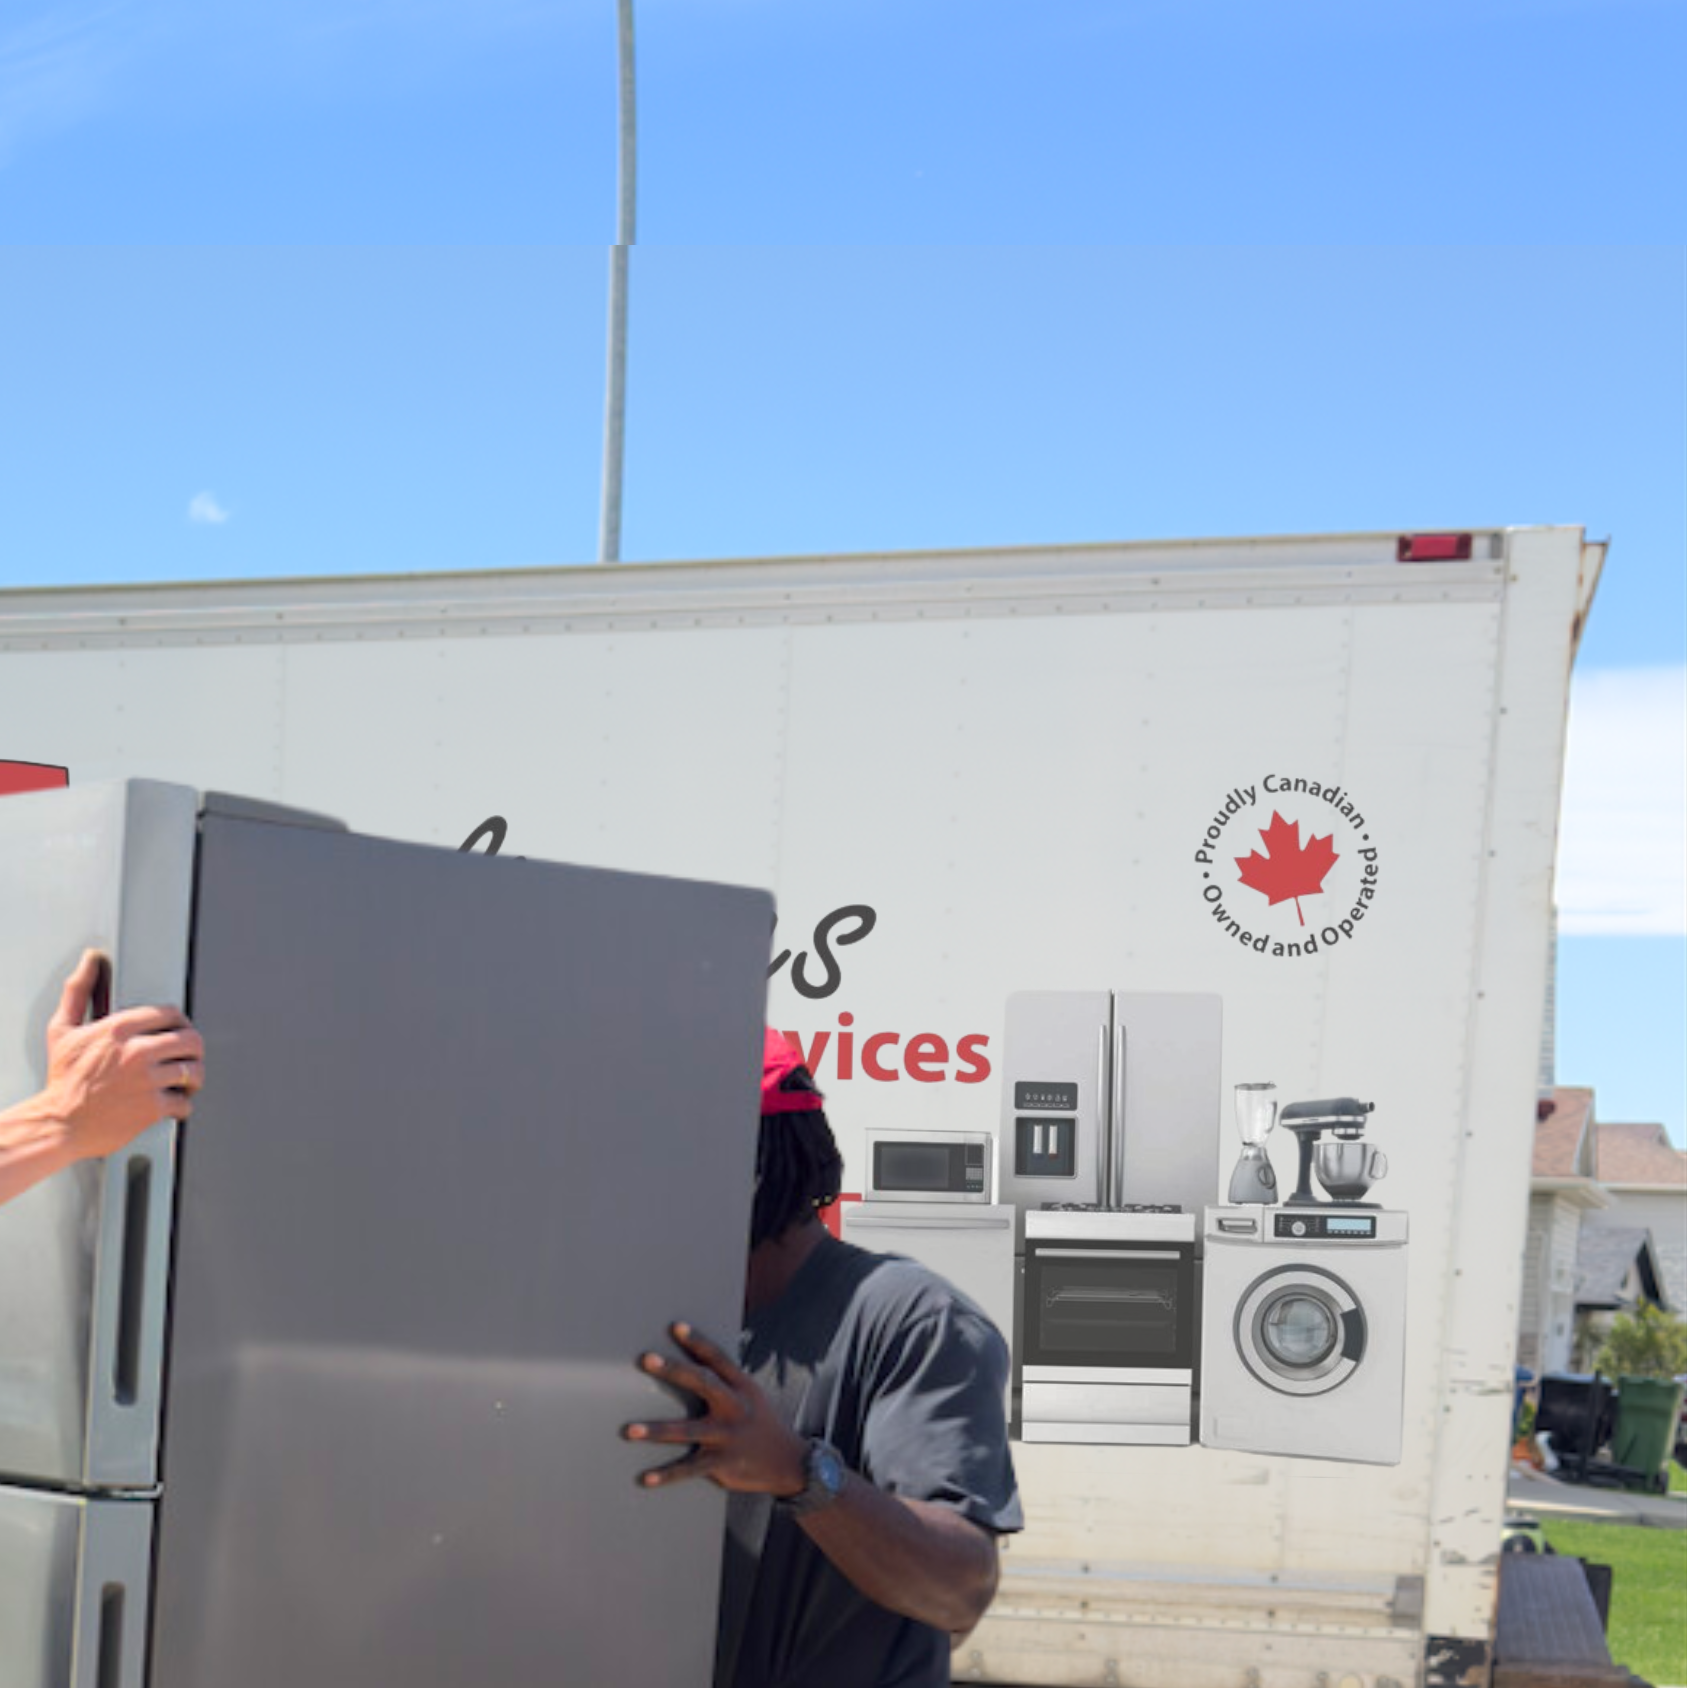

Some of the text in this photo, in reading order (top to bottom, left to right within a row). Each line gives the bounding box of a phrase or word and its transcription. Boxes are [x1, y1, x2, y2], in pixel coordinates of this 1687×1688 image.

[1194, 774, 1365, 864] Proudly Canadian
[1203, 846, 1379, 957] Owned and Operated
